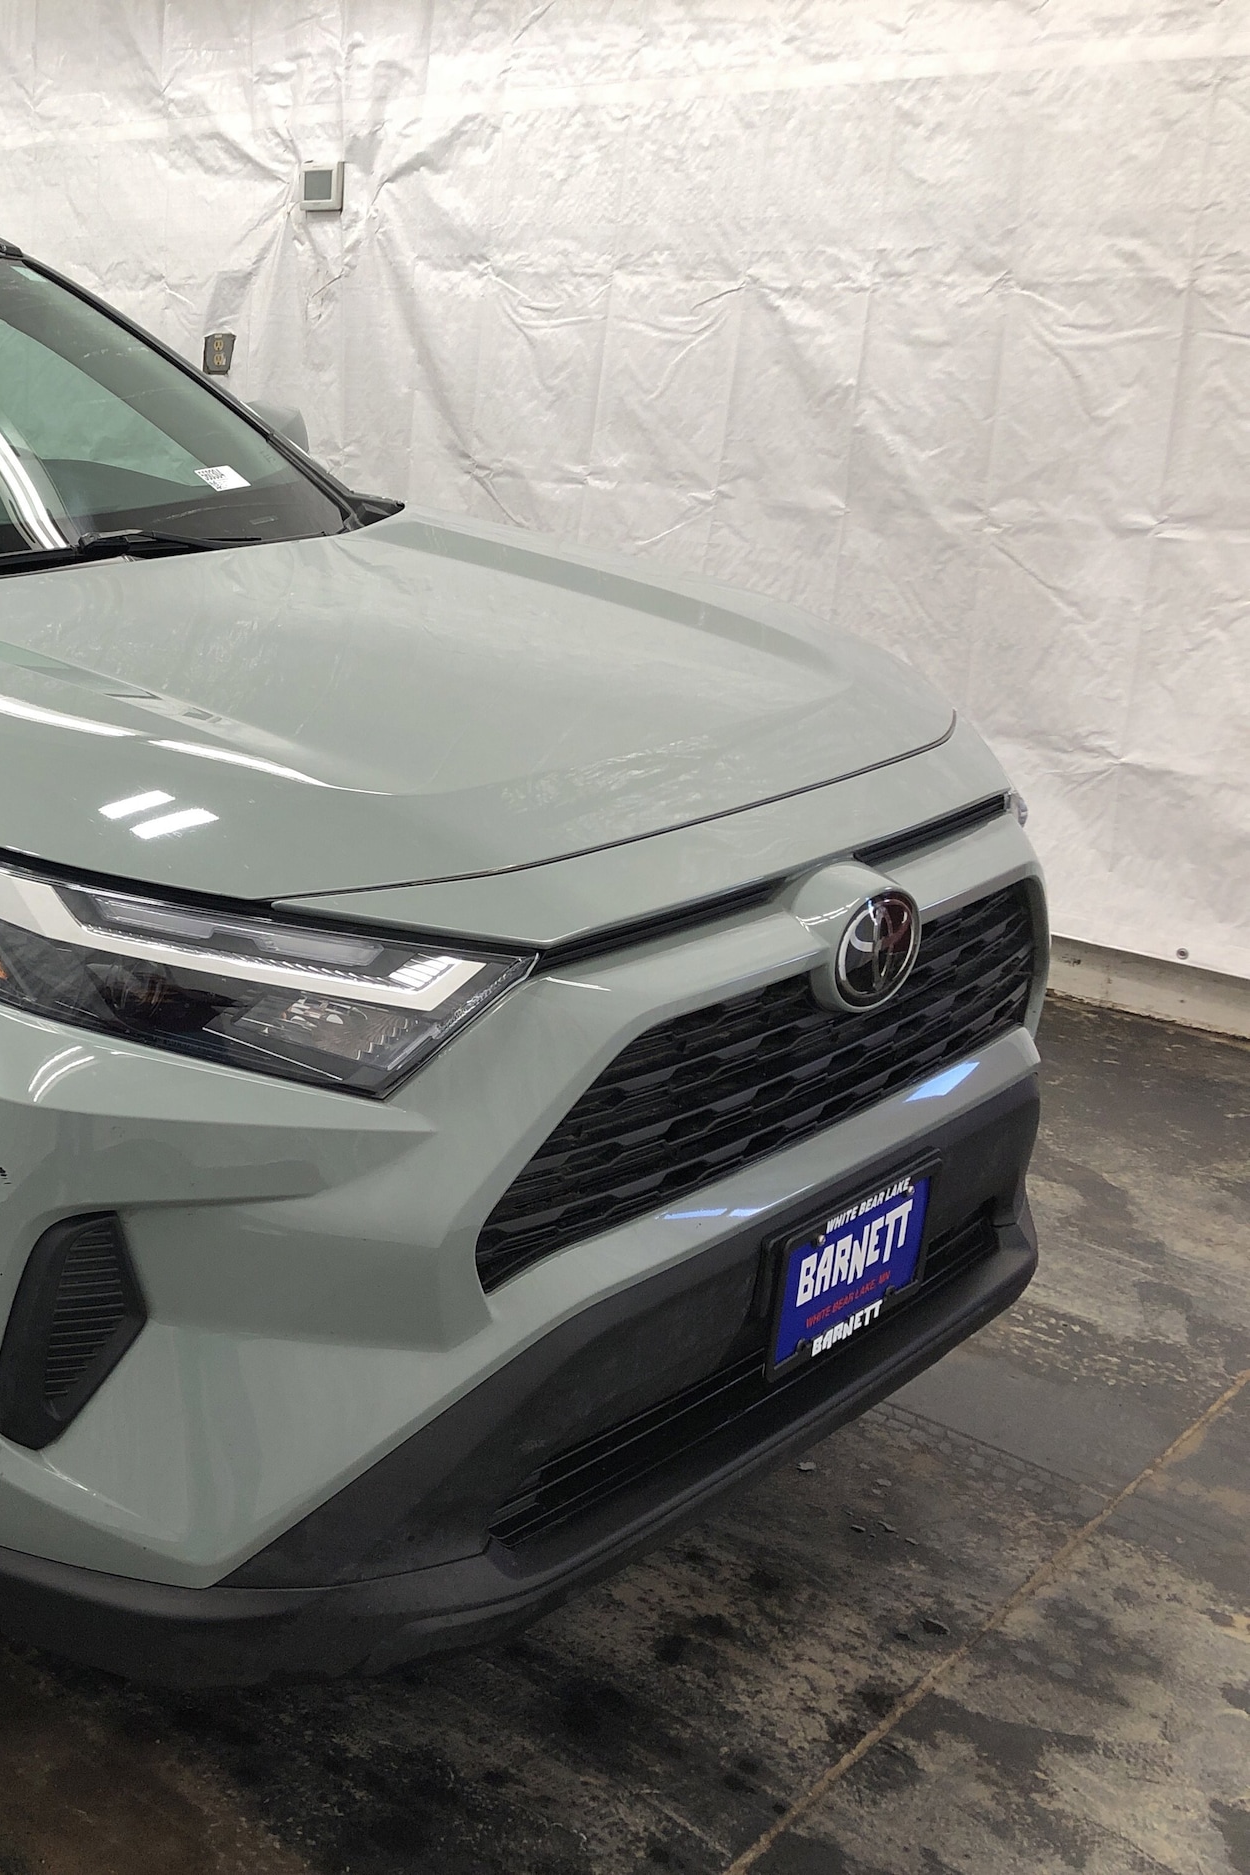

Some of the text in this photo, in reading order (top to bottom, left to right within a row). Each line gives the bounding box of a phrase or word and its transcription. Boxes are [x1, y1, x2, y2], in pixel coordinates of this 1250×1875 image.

[826, 1177, 911, 1234] WHITE BEAR LAKE
[796, 1199, 913, 1307] BARNETT
[806, 1308, 832, 1328] WHITE
[832, 1294, 855, 1313] BEAR
[811, 1299, 883, 1357] BARNETT
